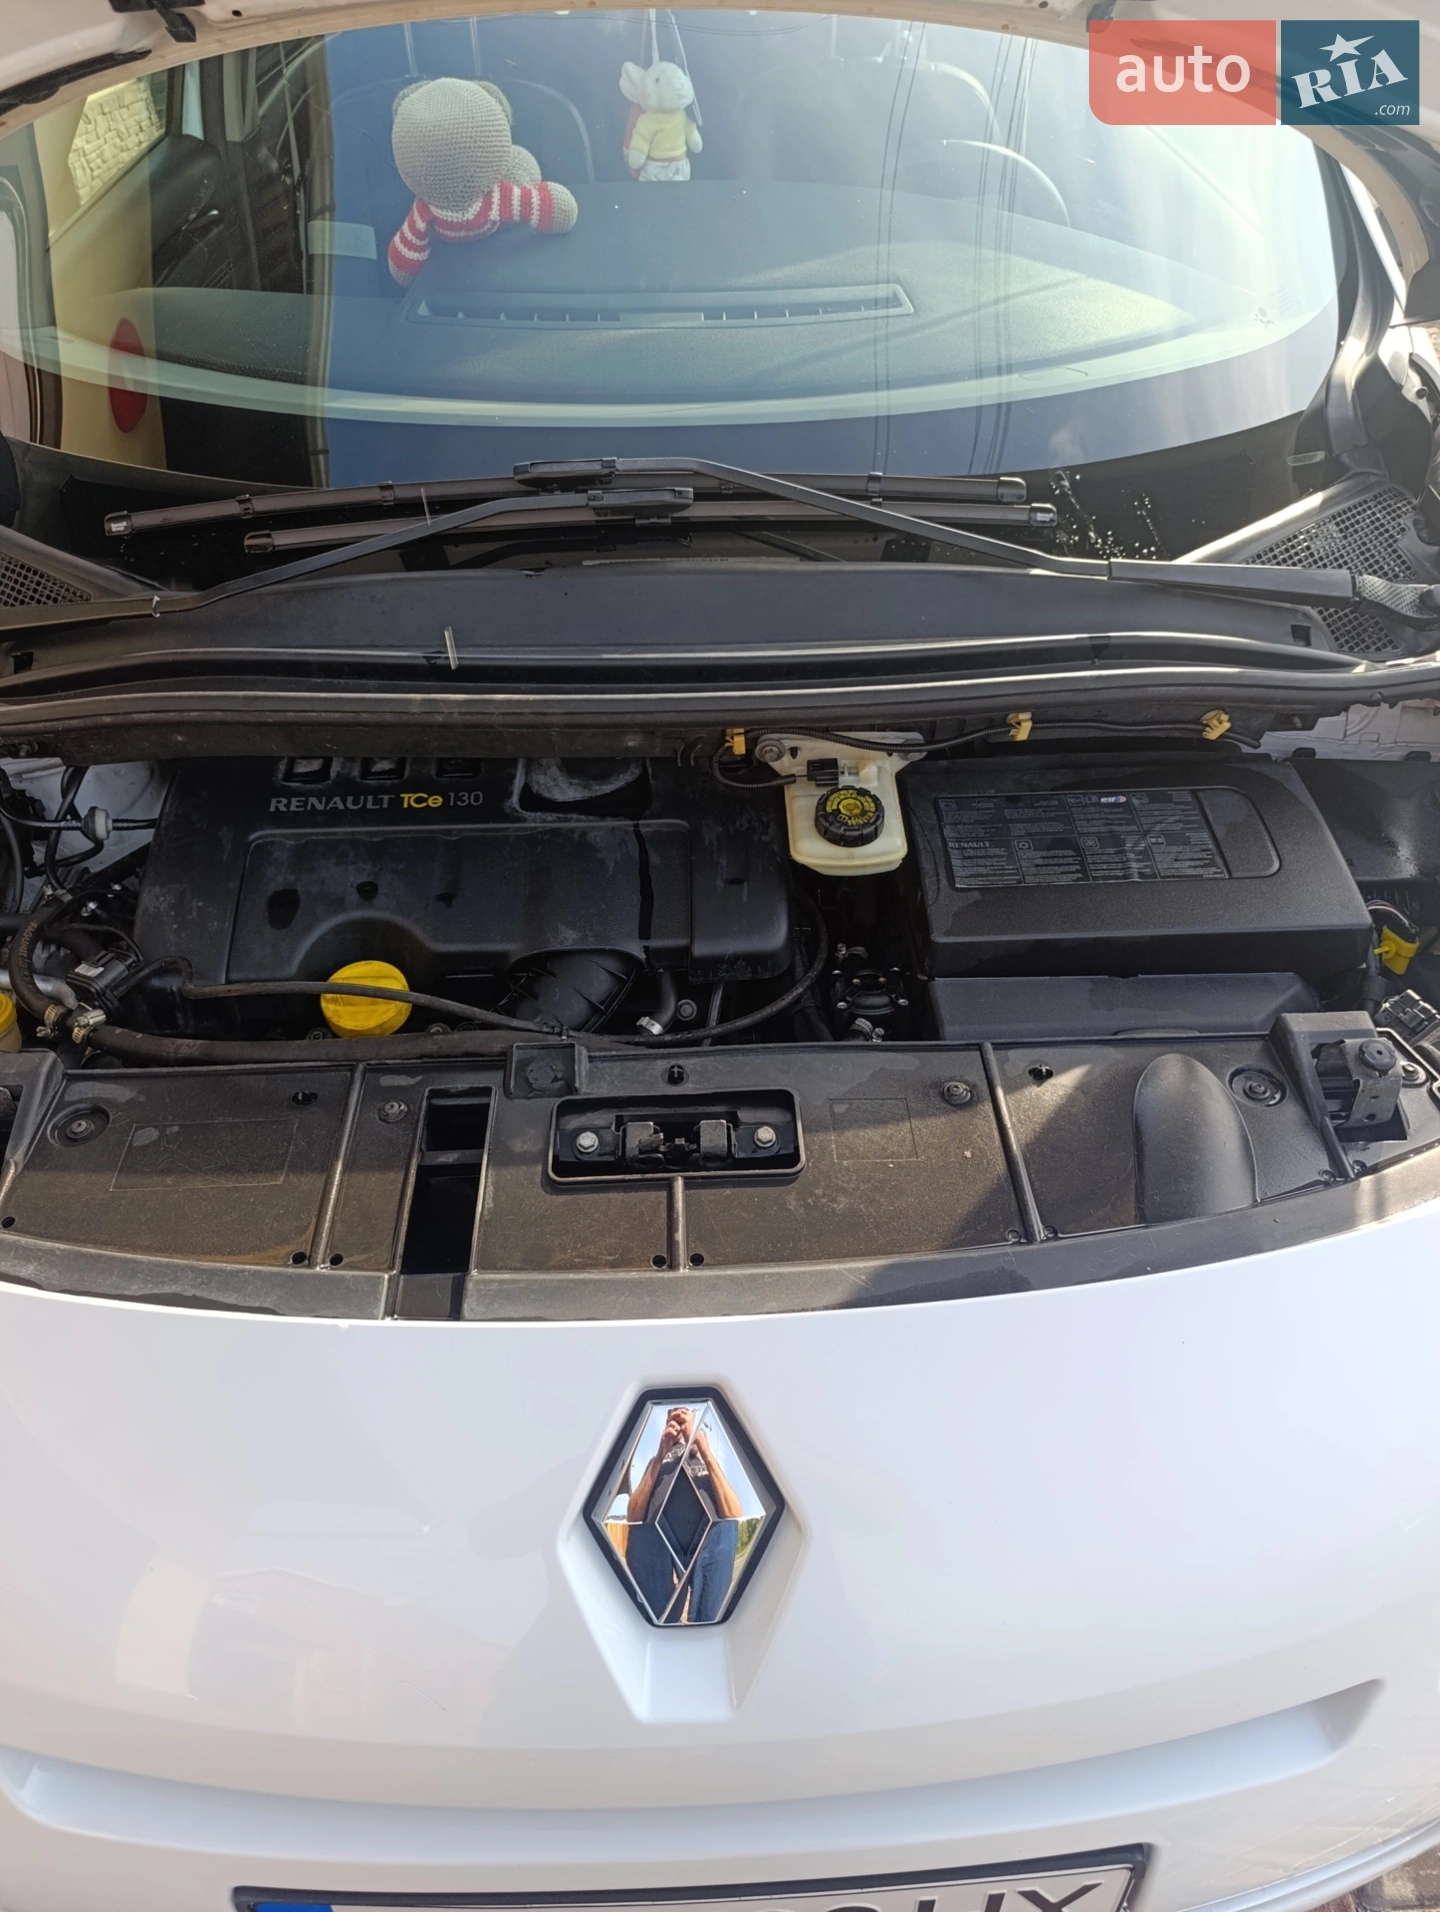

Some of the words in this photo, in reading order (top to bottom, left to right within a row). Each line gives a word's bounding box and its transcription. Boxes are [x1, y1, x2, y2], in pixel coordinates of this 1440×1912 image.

[269, 794, 395, 812] RENAULT
[400, 792, 443, 808] TCe
[447, 791, 484, 807] 130
[948, 841, 990, 849] RENAULT
